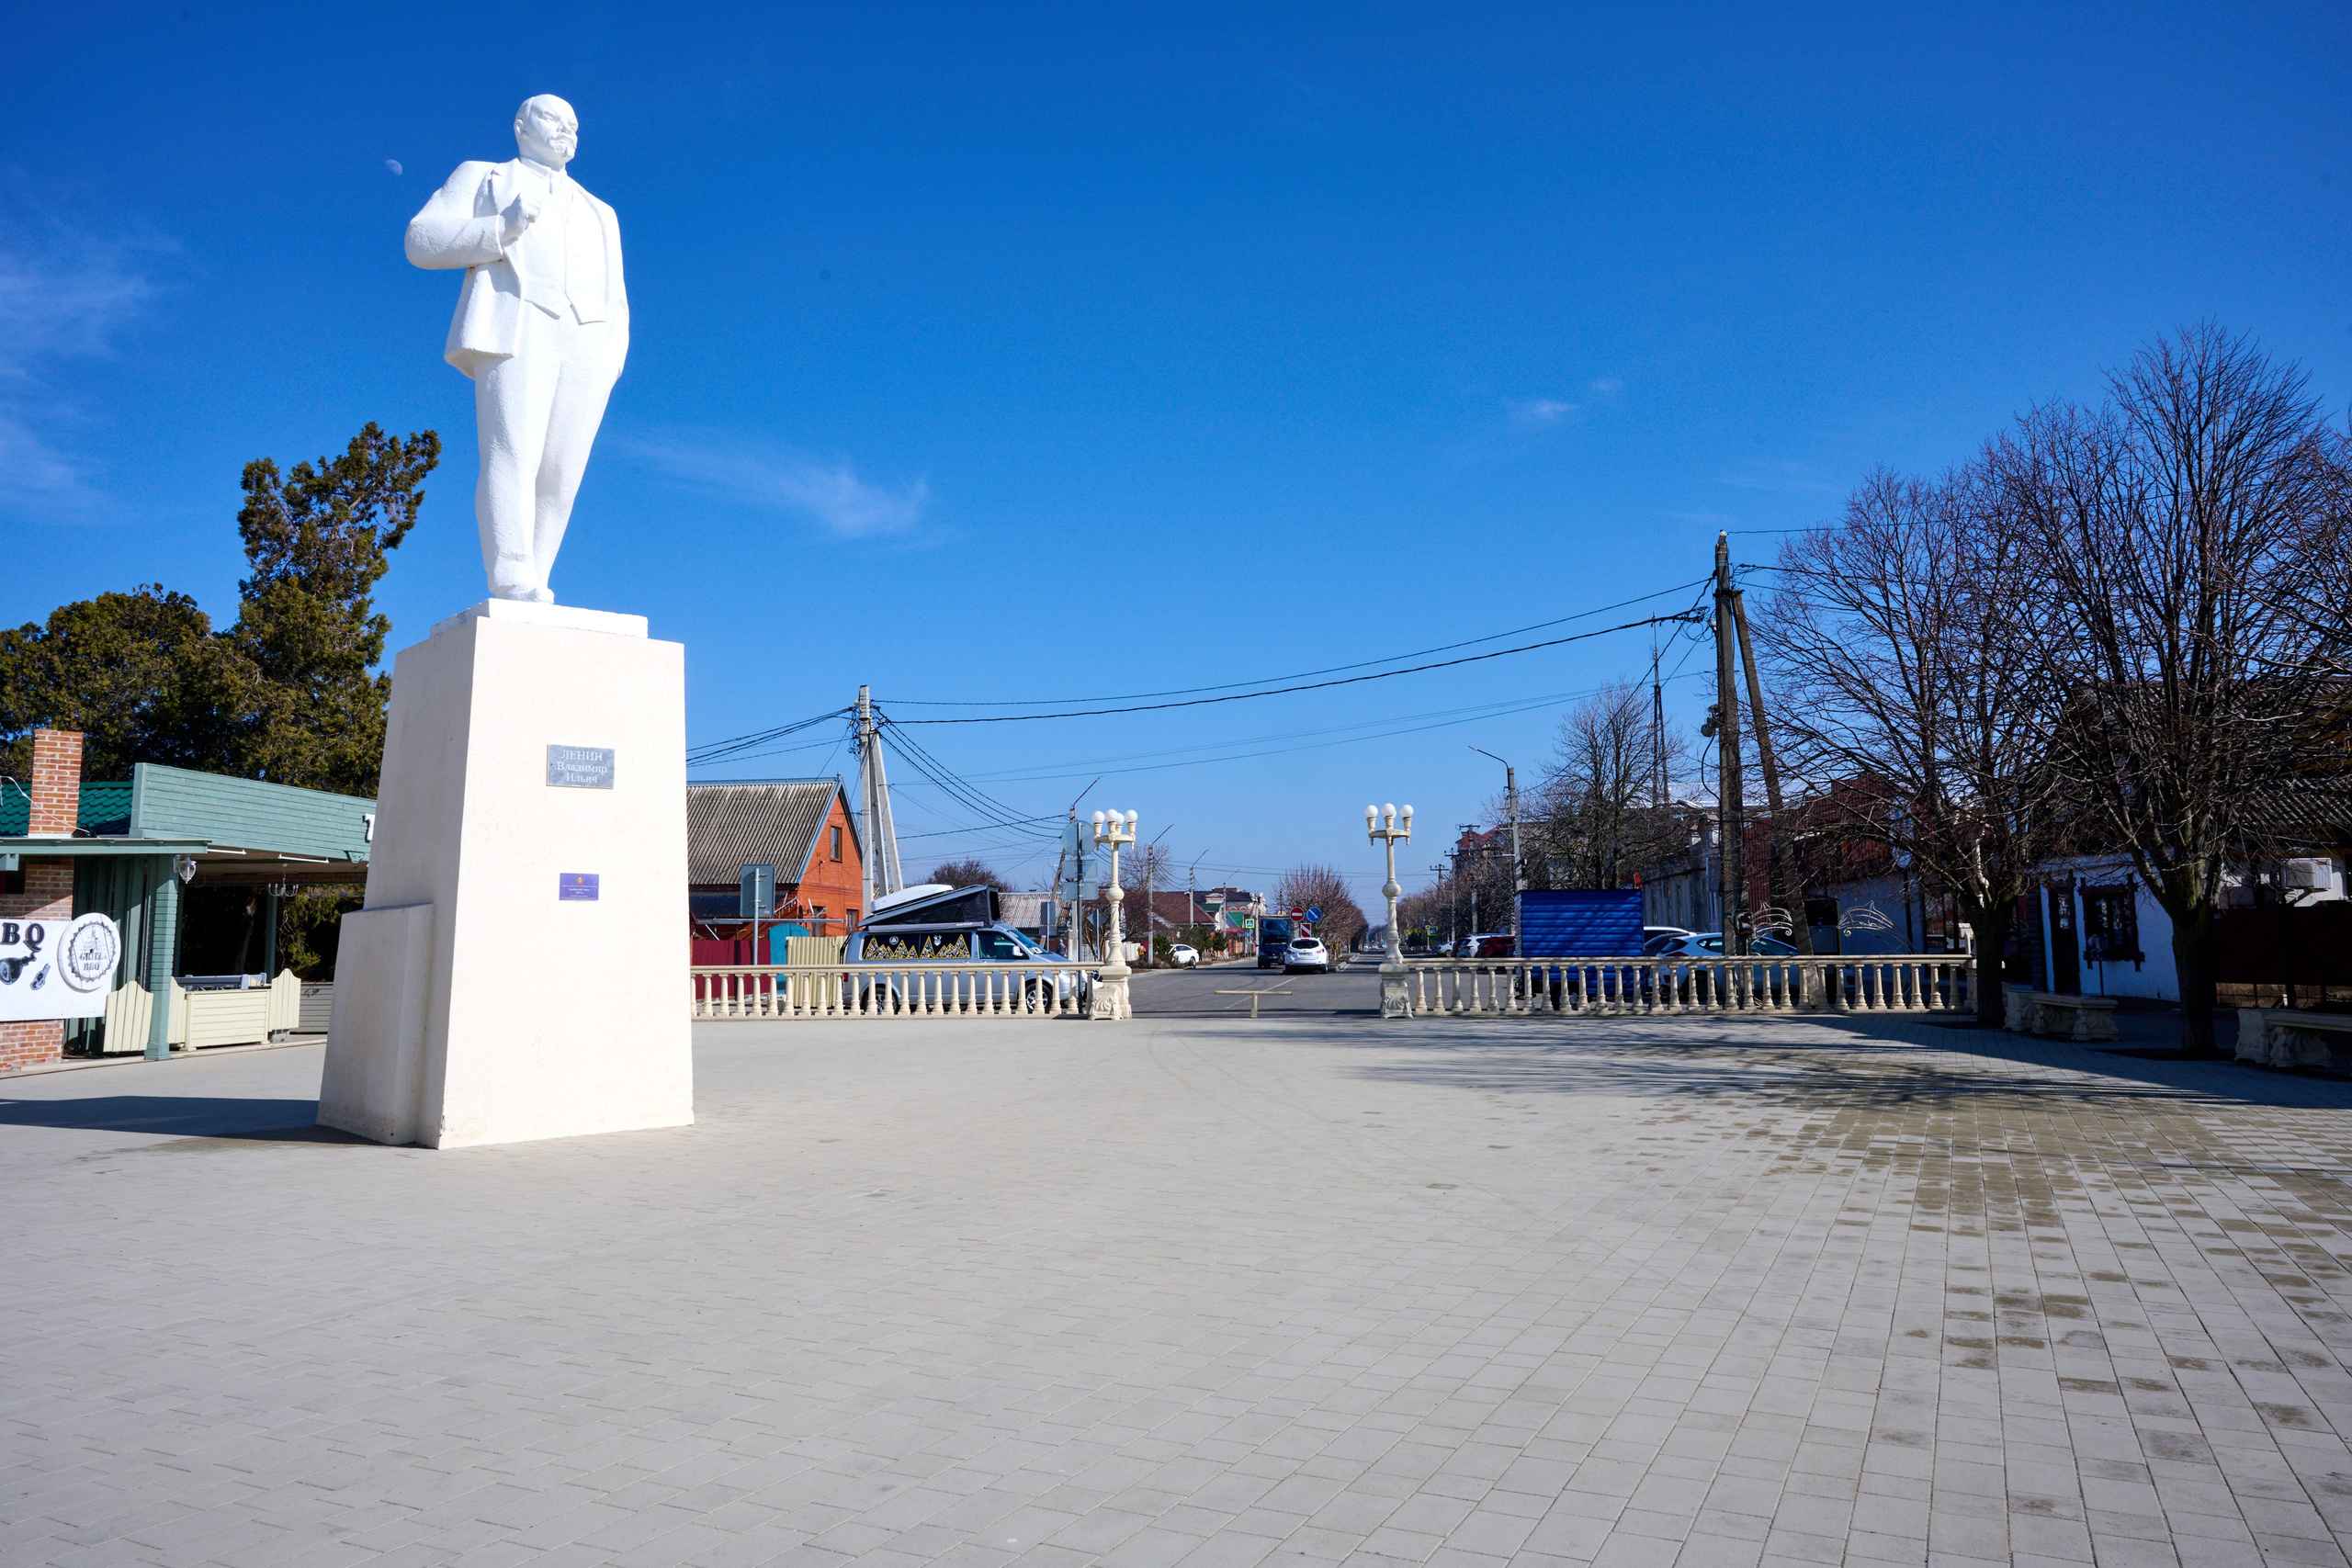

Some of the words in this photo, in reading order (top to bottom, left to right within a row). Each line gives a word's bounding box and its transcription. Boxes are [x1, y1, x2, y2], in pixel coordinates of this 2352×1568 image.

[561, 750, 603, 761] ЛЕНИН
[557, 761, 607, 776] Владимир
[566, 773, 598, 783] Ильич
[79, 953, 103, 961] GRILL
[84, 963, 99, 971] BBQ
